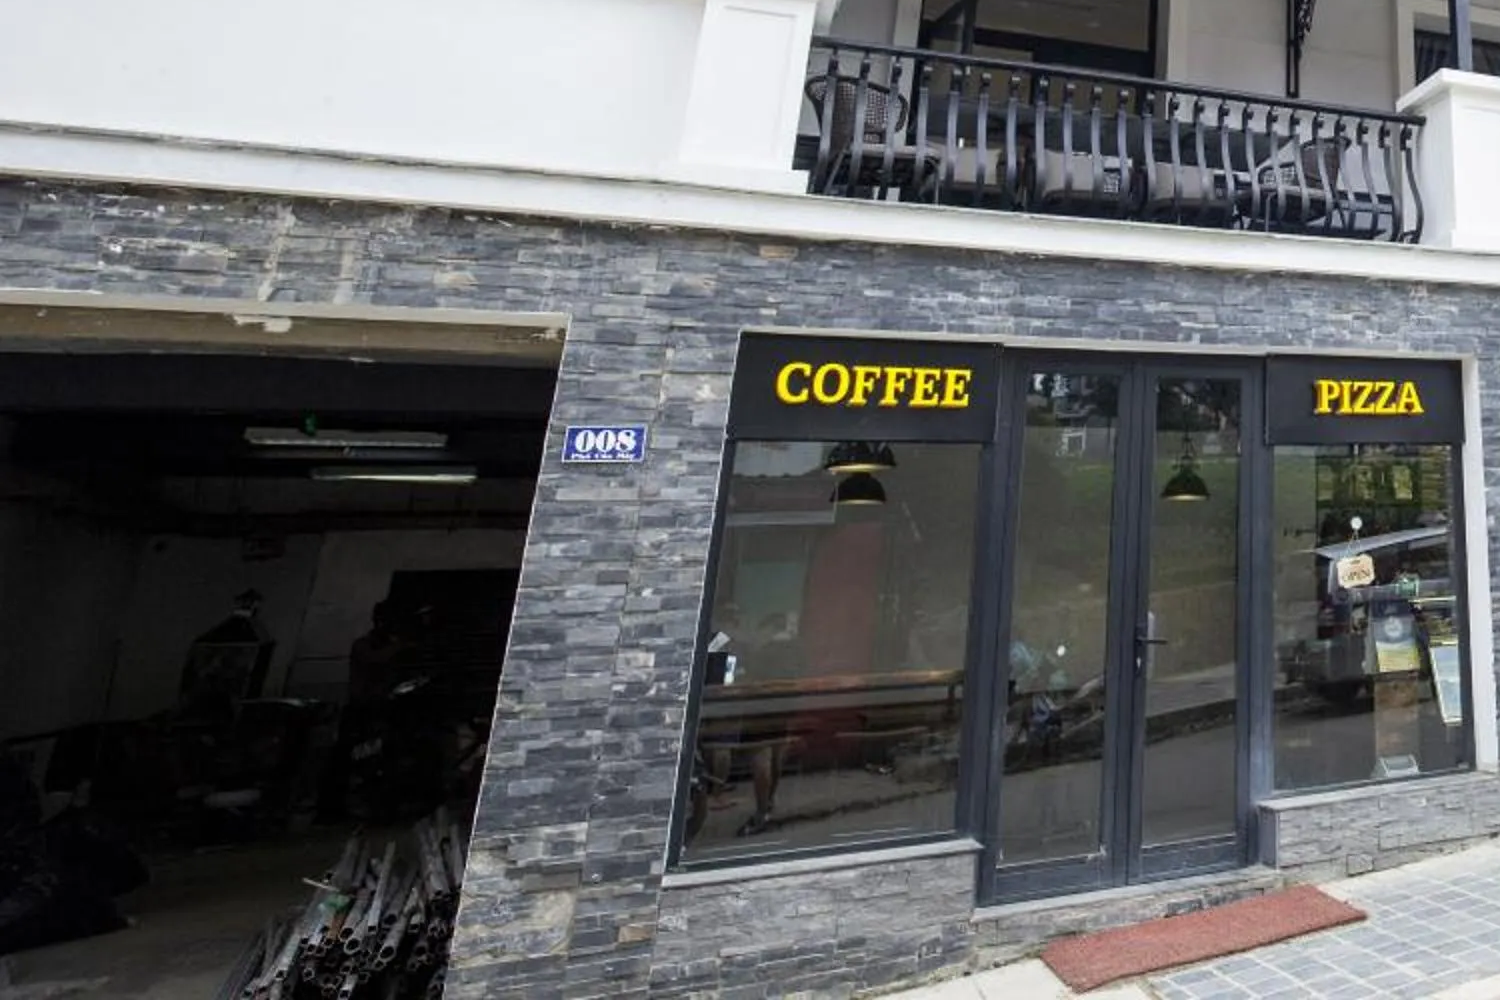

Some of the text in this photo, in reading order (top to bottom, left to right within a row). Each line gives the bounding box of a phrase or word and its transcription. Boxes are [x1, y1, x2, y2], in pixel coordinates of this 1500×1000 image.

[775, 361, 973, 408] COFFEE
[1313, 379, 1425, 415] PIZZA
[575, 429, 637, 453] 008
